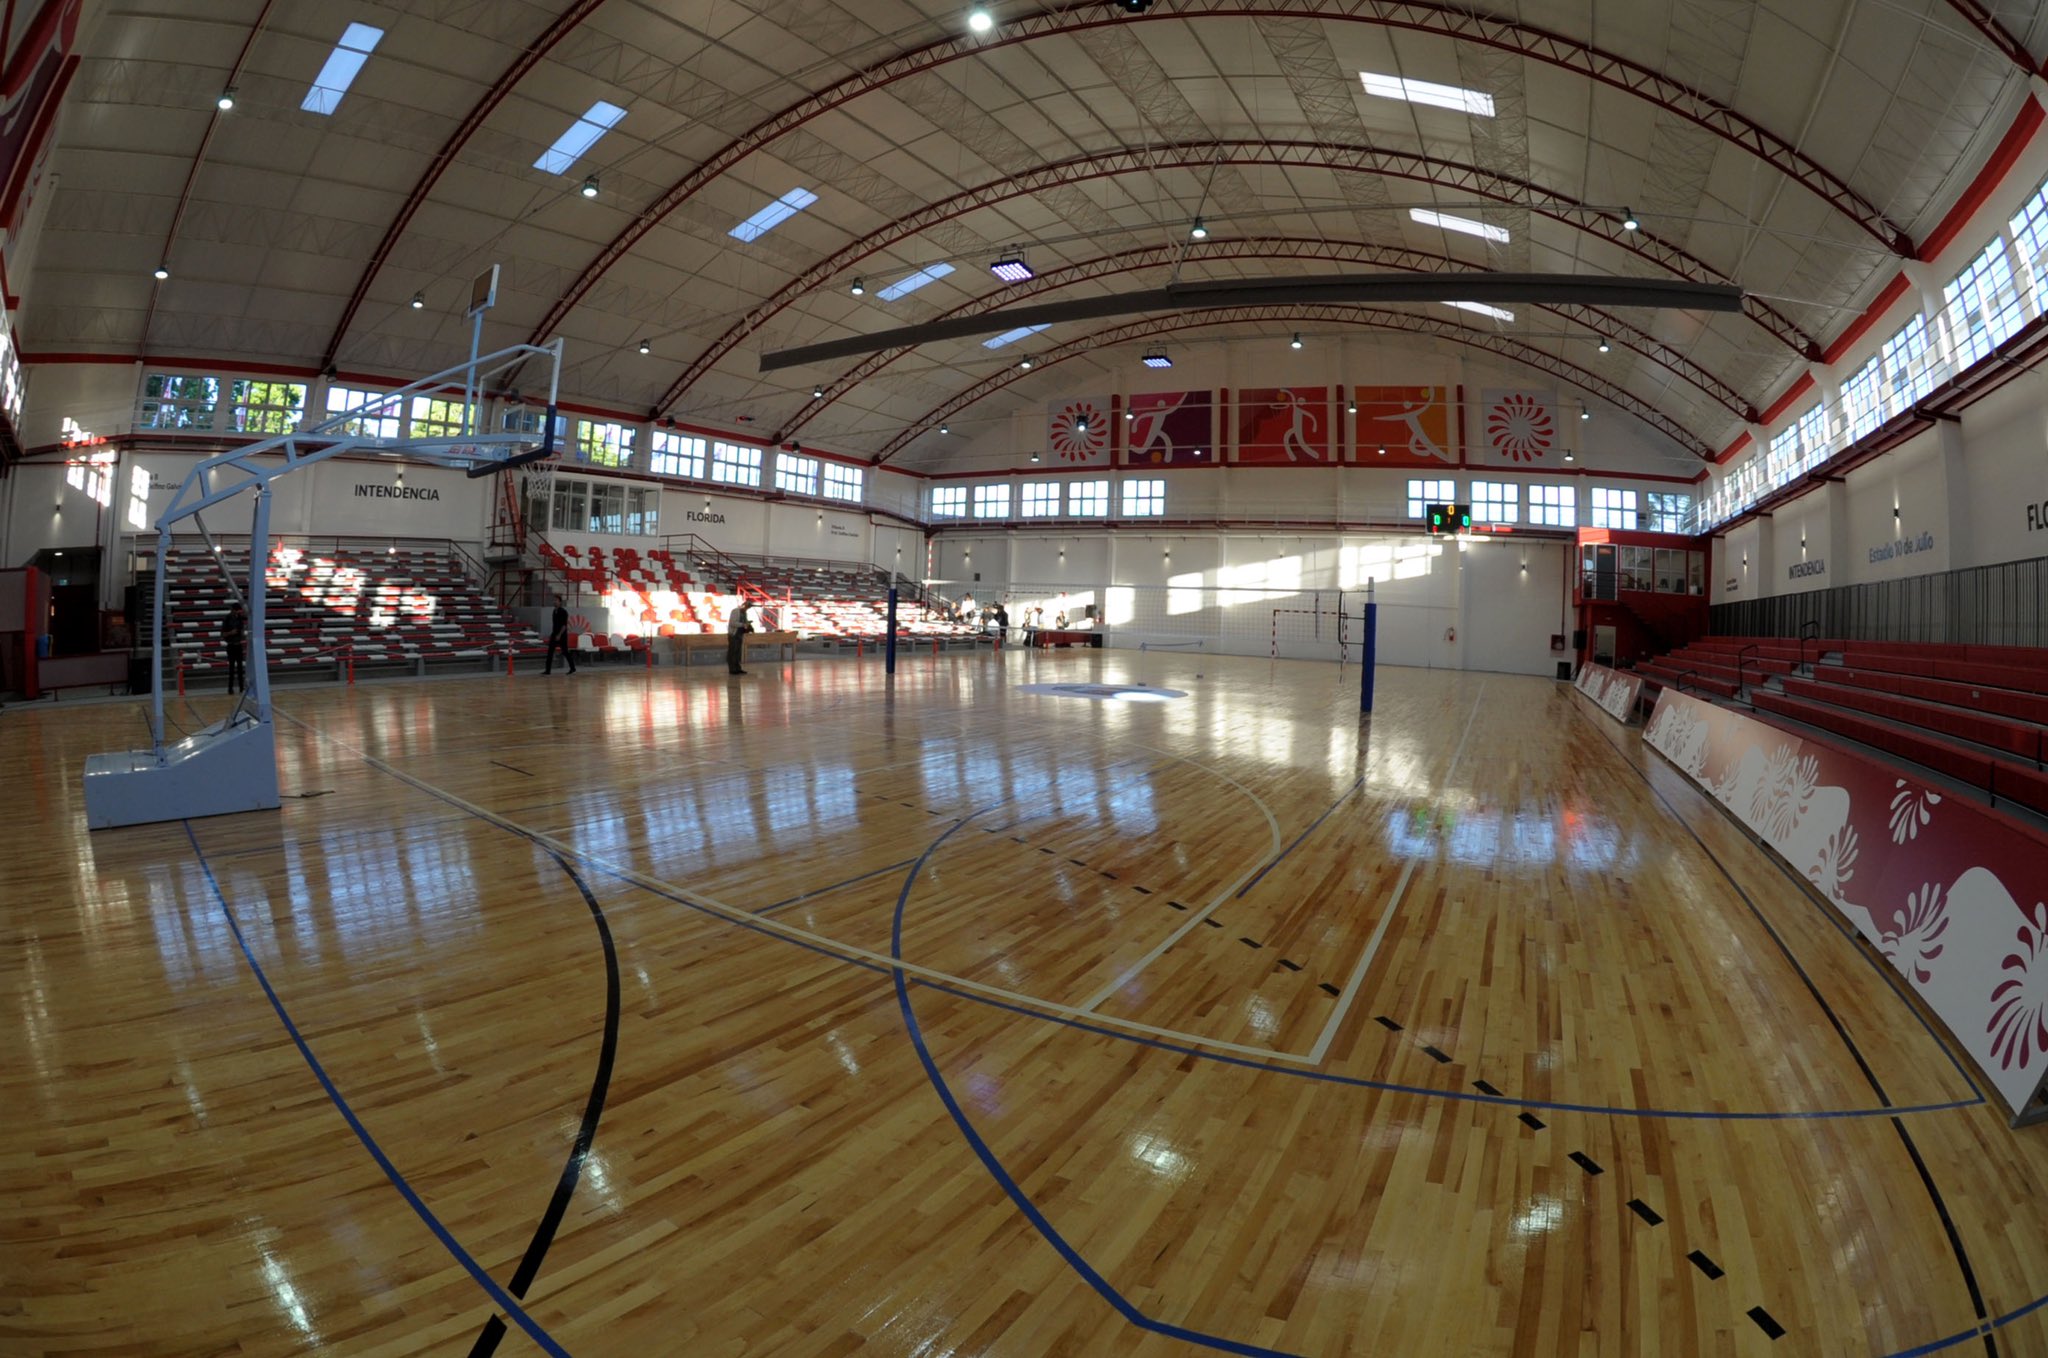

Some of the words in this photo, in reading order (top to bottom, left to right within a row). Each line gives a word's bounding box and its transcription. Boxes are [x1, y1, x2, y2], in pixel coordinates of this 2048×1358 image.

[355, 484, 440, 501] INTENDENCIA
[686, 511, 726, 524] FLORIDA
[1904, 535, 1914, 555] de
[1788, 559, 1825, 580] INTENDENCIA
